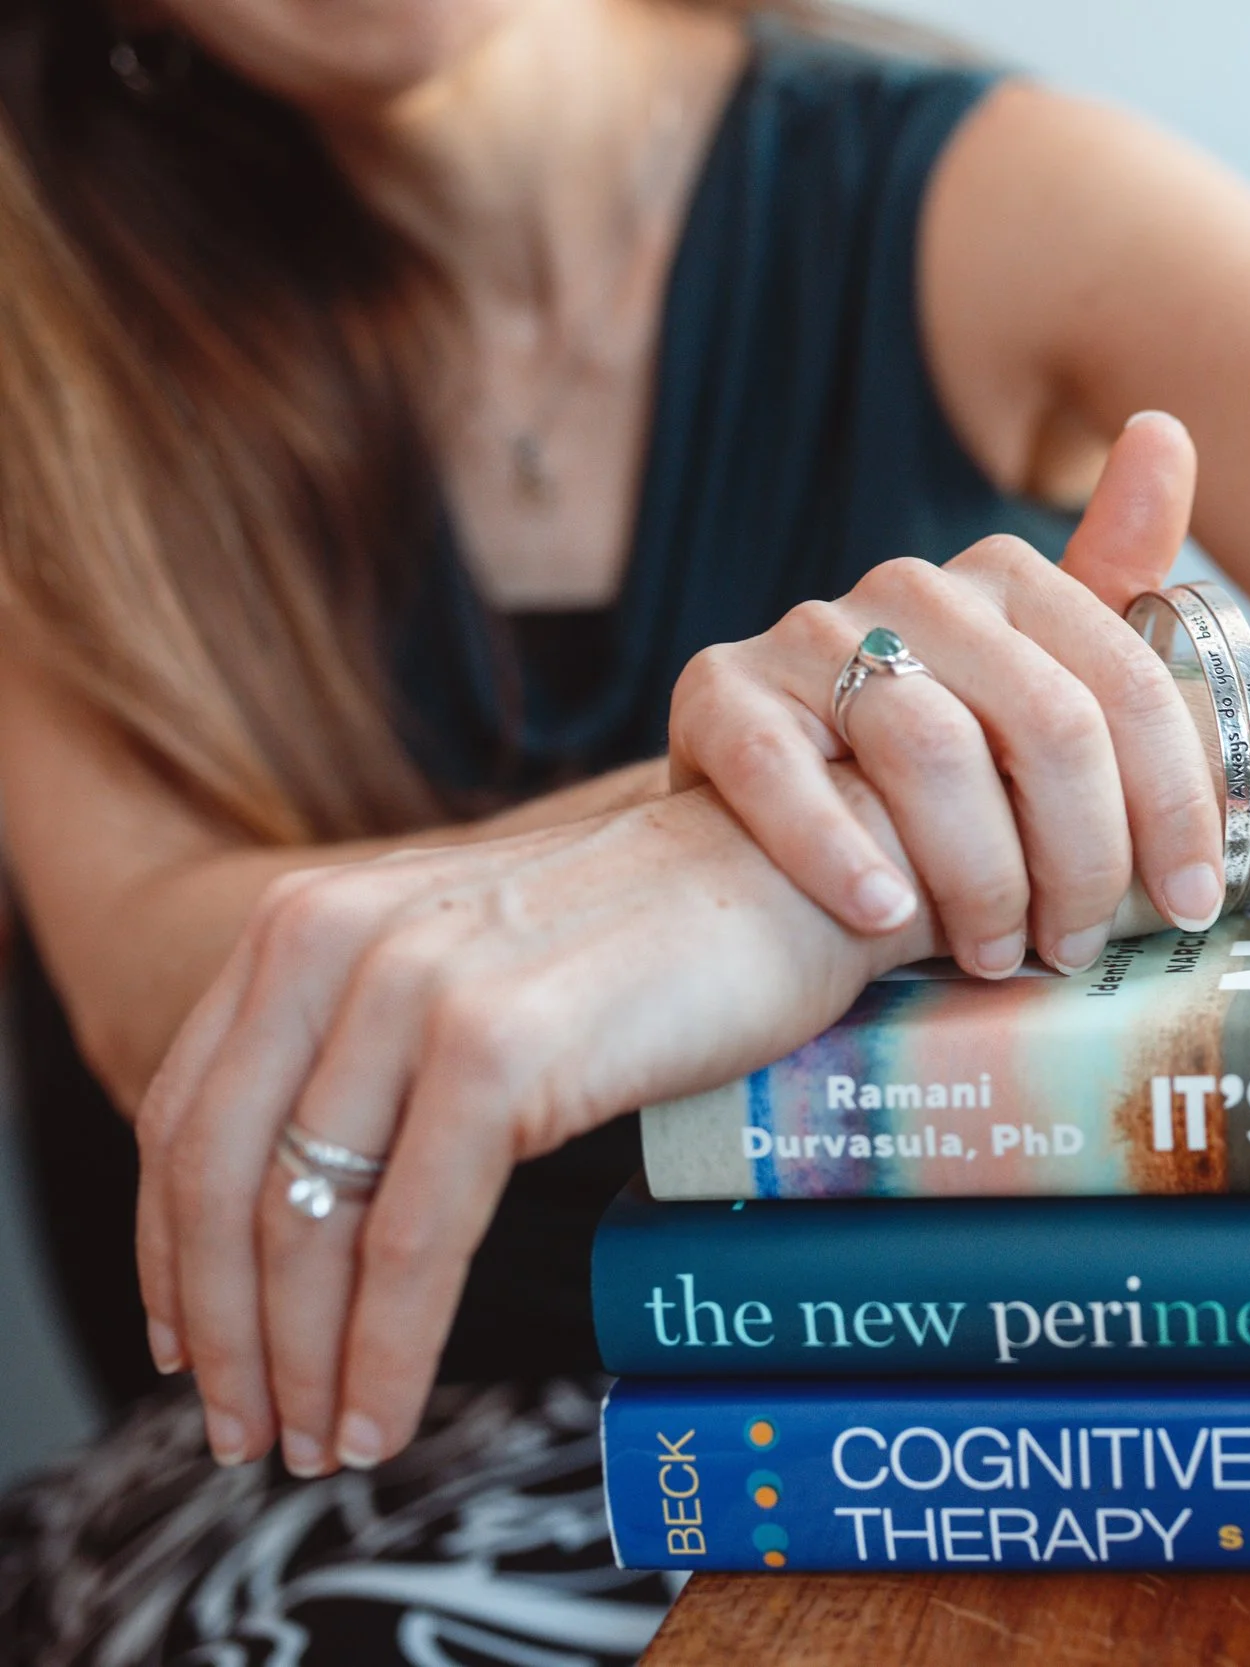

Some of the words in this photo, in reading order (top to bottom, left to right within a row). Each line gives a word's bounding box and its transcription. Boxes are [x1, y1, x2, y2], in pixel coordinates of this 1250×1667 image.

[1192, 615, 1210, 640] best
[1208, 651, 1234, 685] your
[1218, 697, 1234, 718] do
[1229, 733, 1248, 799] Always
[827, 1073, 992, 1110] Ramani
[741, 1126, 977, 1161] Durvasula,
[992, 1124, 1084, 1156] PhD
[644, 1273, 775, 1347] the
[798, 1300, 967, 1348] new
[656, 1428, 706, 1556] BECK
[833, 1507, 1193, 1562] THERAPY
